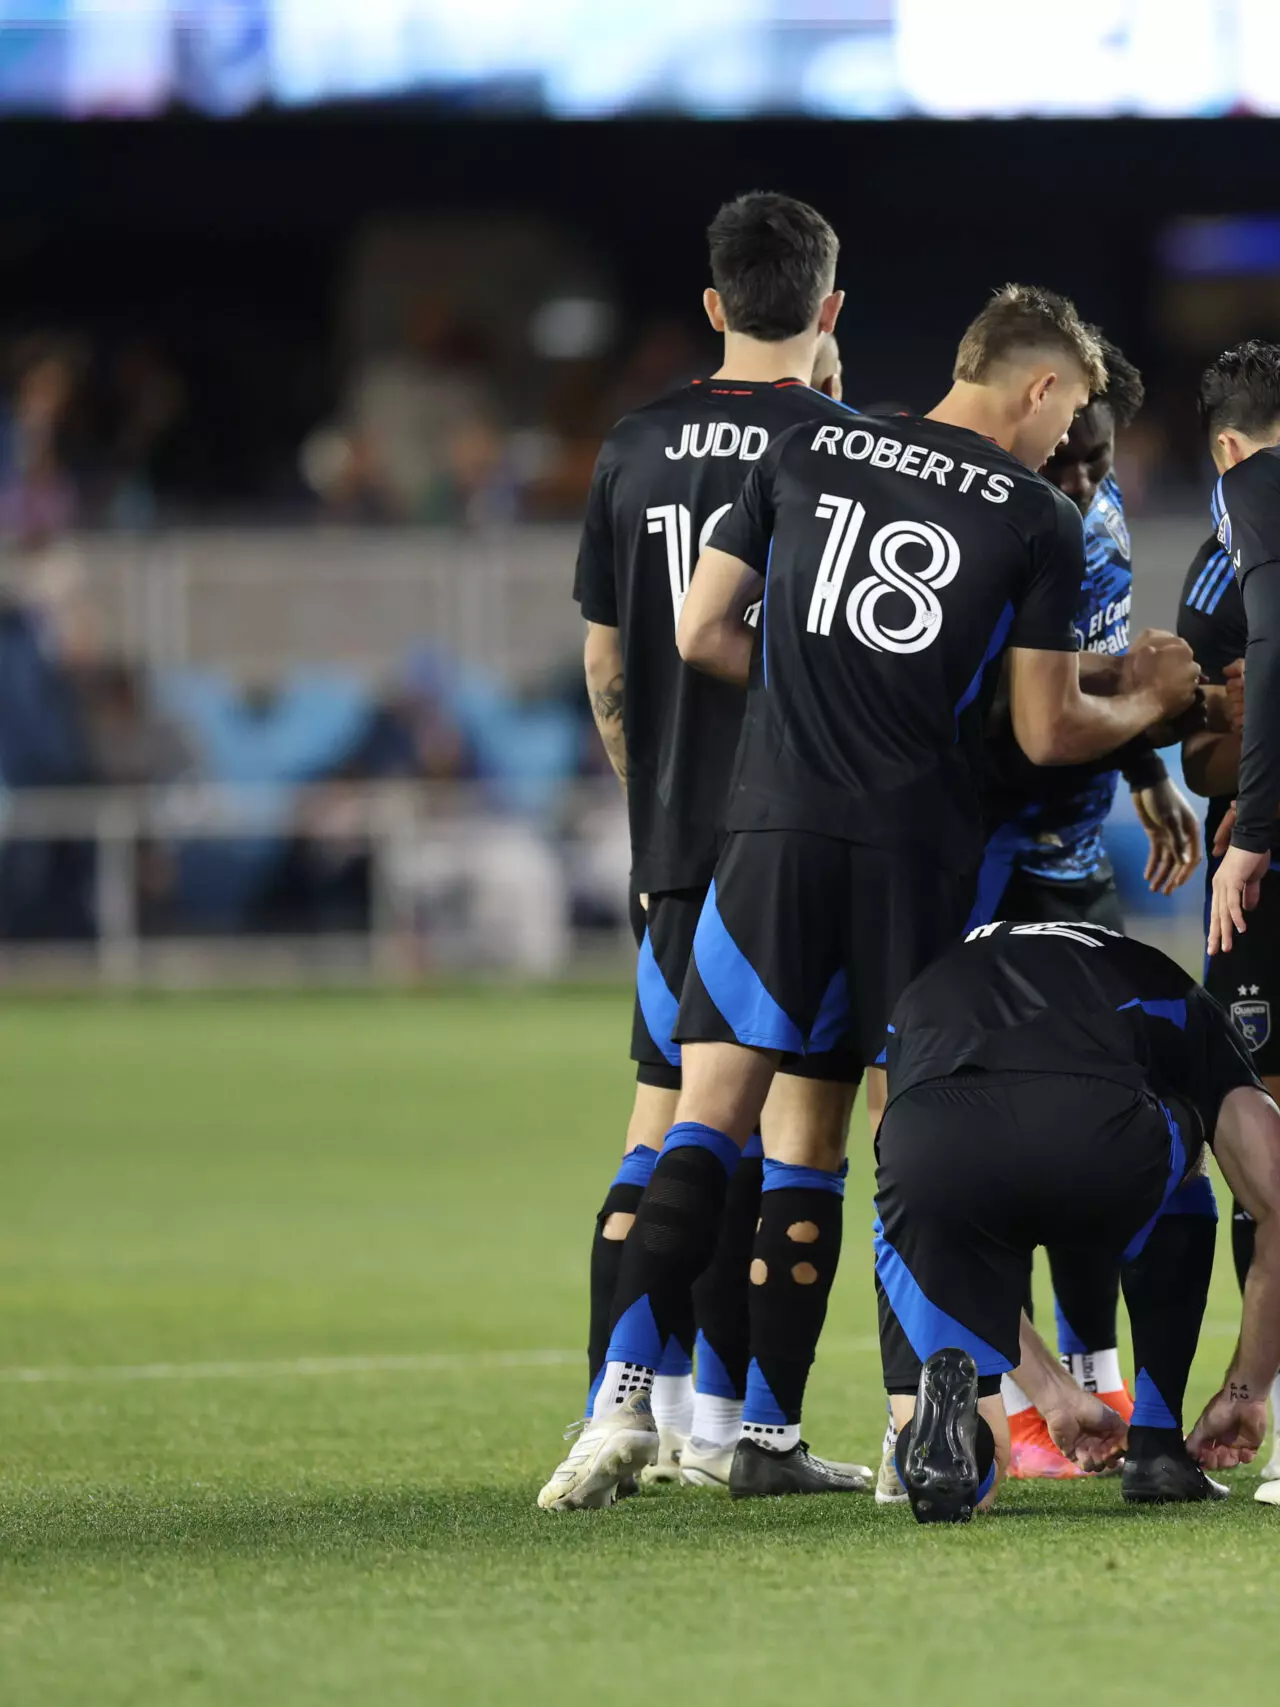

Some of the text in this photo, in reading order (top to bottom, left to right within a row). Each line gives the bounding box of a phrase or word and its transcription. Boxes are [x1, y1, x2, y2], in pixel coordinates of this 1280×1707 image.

[664, 421, 769, 461] JUDD
[811, 425, 1015, 504] ROBERTS
[806, 492, 961, 655] 18
[1087, 619, 1130, 655] Healt
